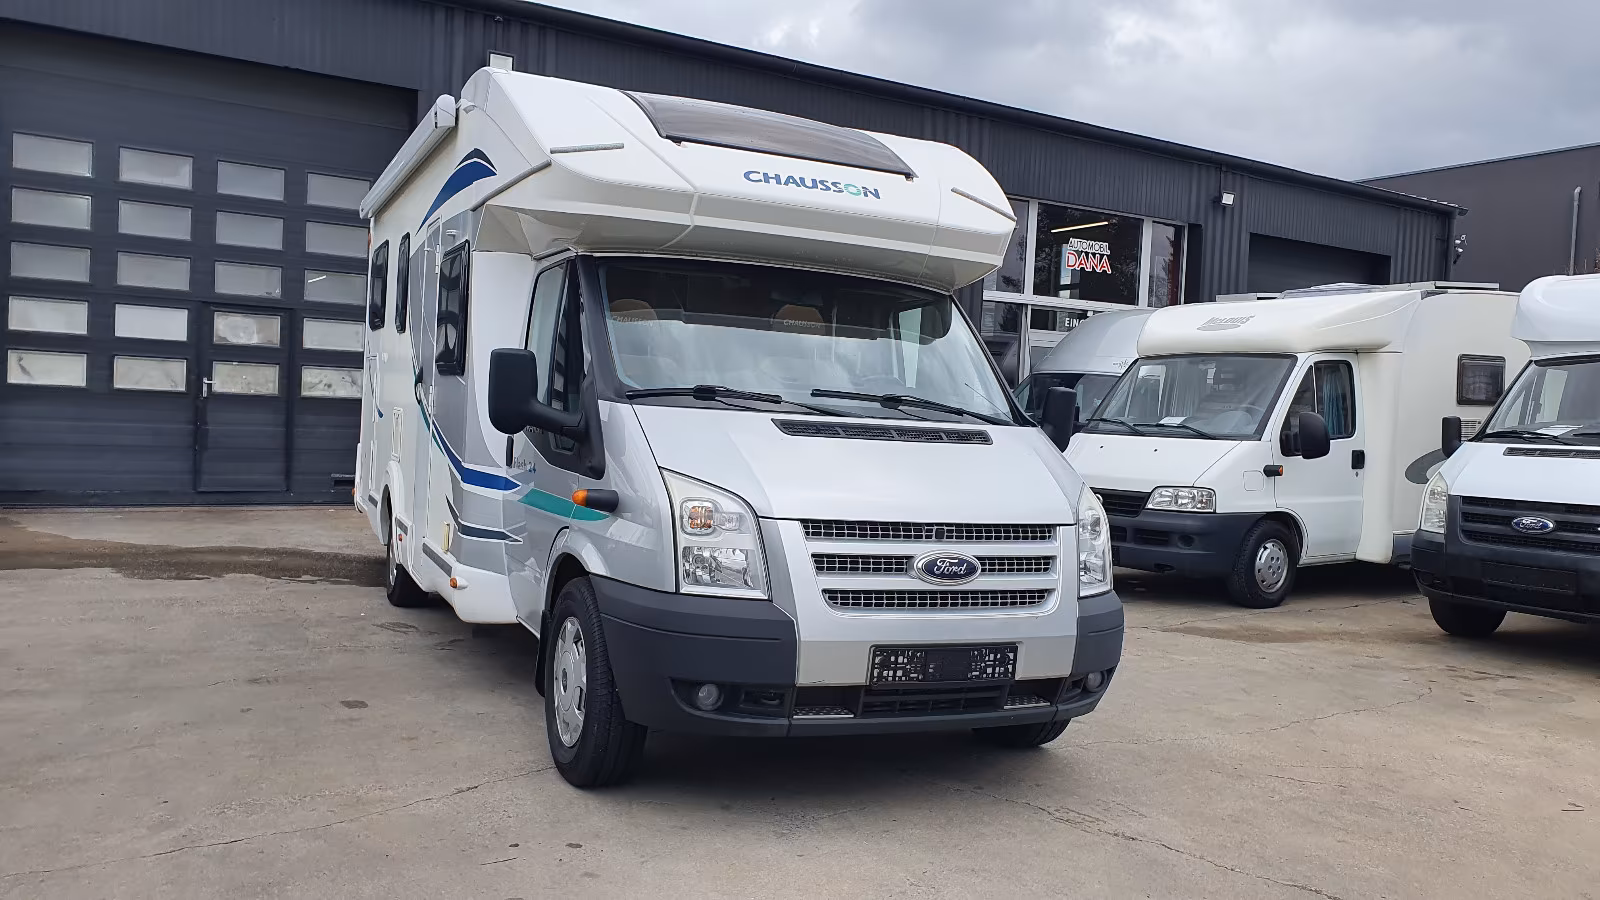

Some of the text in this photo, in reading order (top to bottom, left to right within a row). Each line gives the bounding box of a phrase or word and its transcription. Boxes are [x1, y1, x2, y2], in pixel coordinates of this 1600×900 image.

[743, 171, 881, 200] CHAUSSON
[1068, 238, 1110, 254] AUTOMOBIL
[1066, 251, 1111, 273] DANA
[1520, 519, 1543, 529] Ford
[934, 558, 967, 574] Ford
